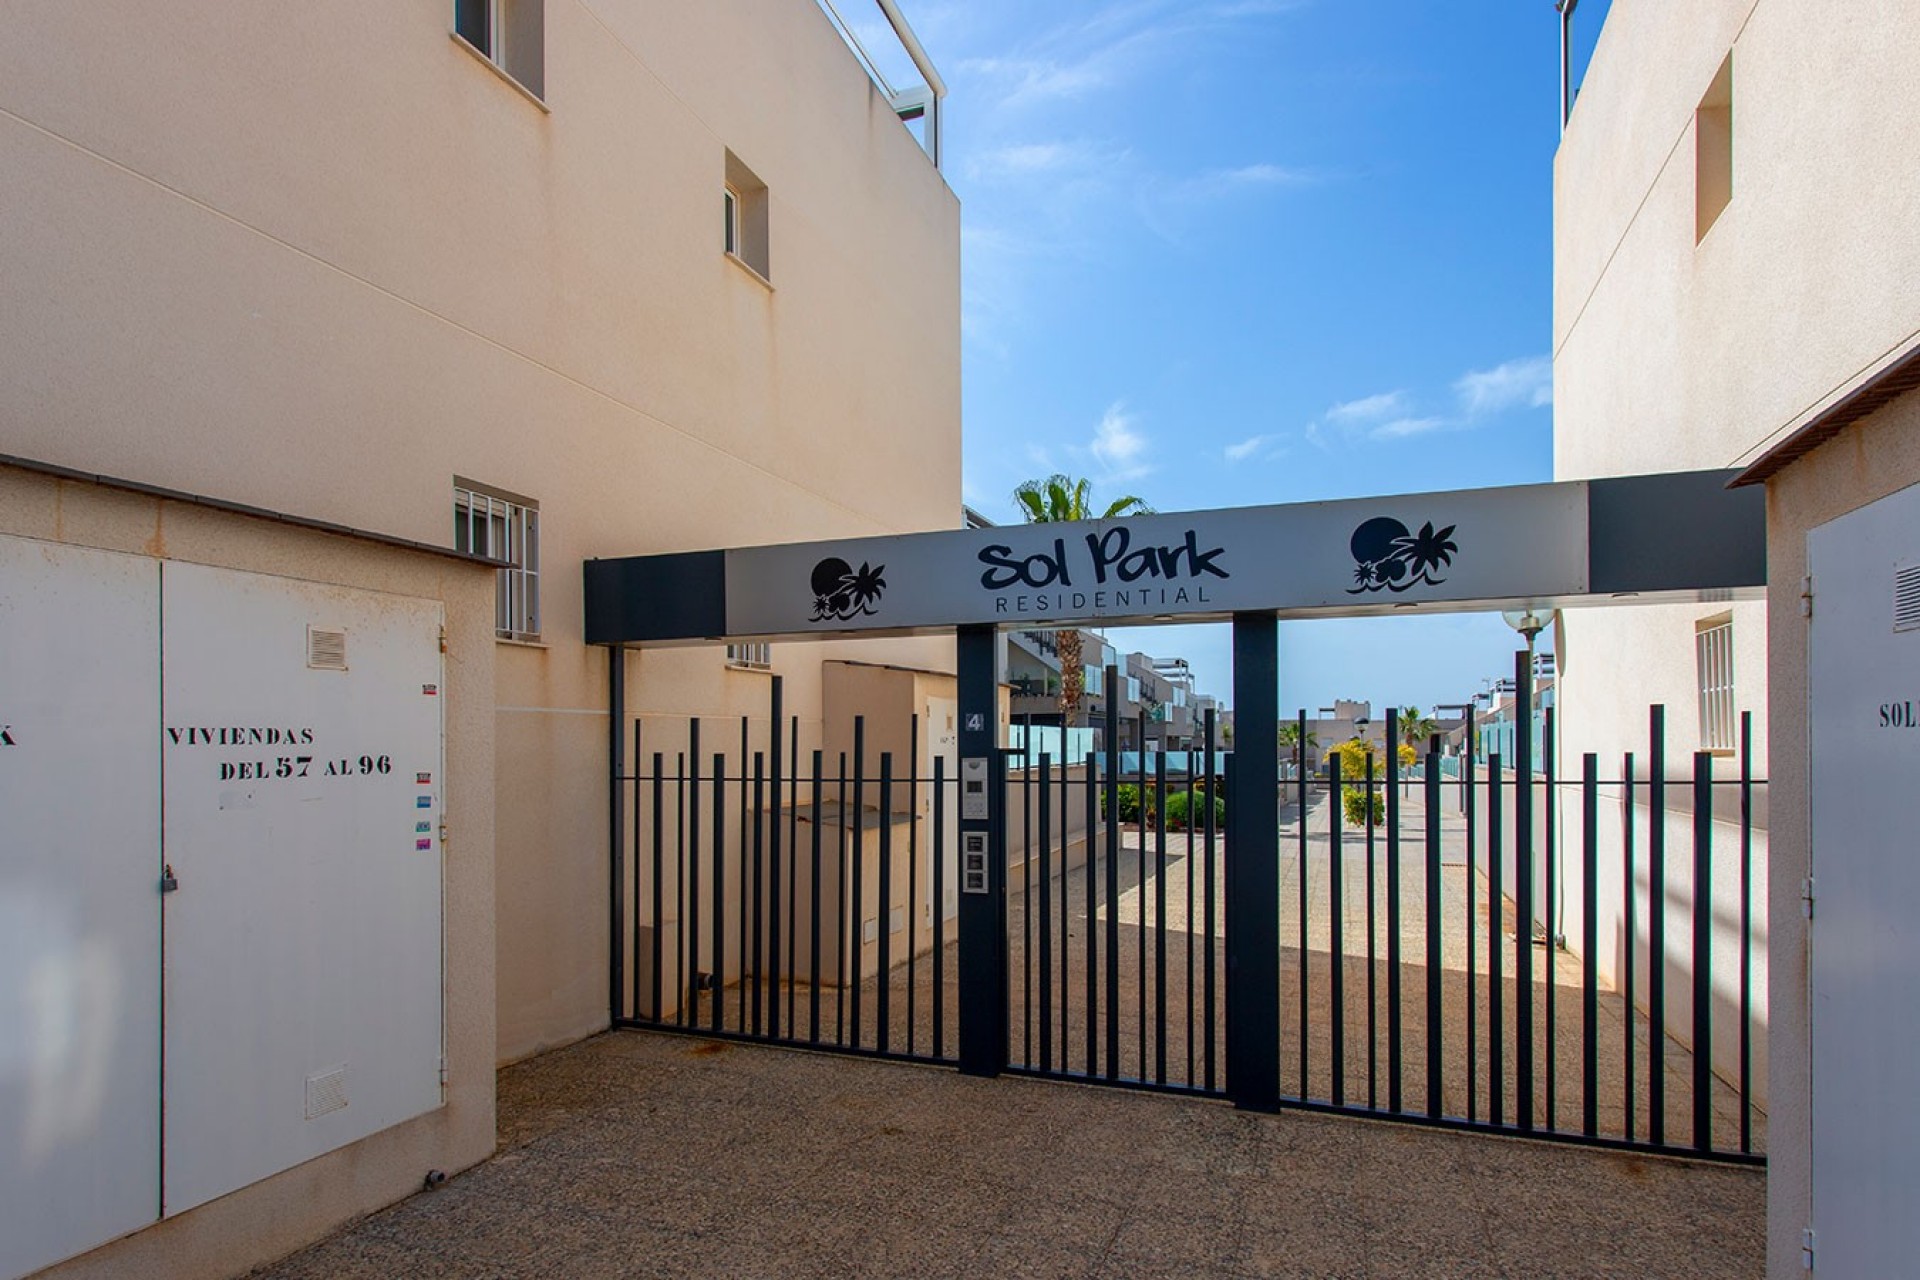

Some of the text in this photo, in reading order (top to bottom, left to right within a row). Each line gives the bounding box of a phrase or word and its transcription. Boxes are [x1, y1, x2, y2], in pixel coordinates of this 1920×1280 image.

[978, 526, 1230, 590] Sol Park
[996, 586, 1210, 613] RESIDENTIAL
[967, 713, 981, 731] 4
[1879, 700, 1920, 728] SOL
[167, 727, 314, 746] VIVIENDAS
[219, 755, 391, 780] DEL 57 AL 96
